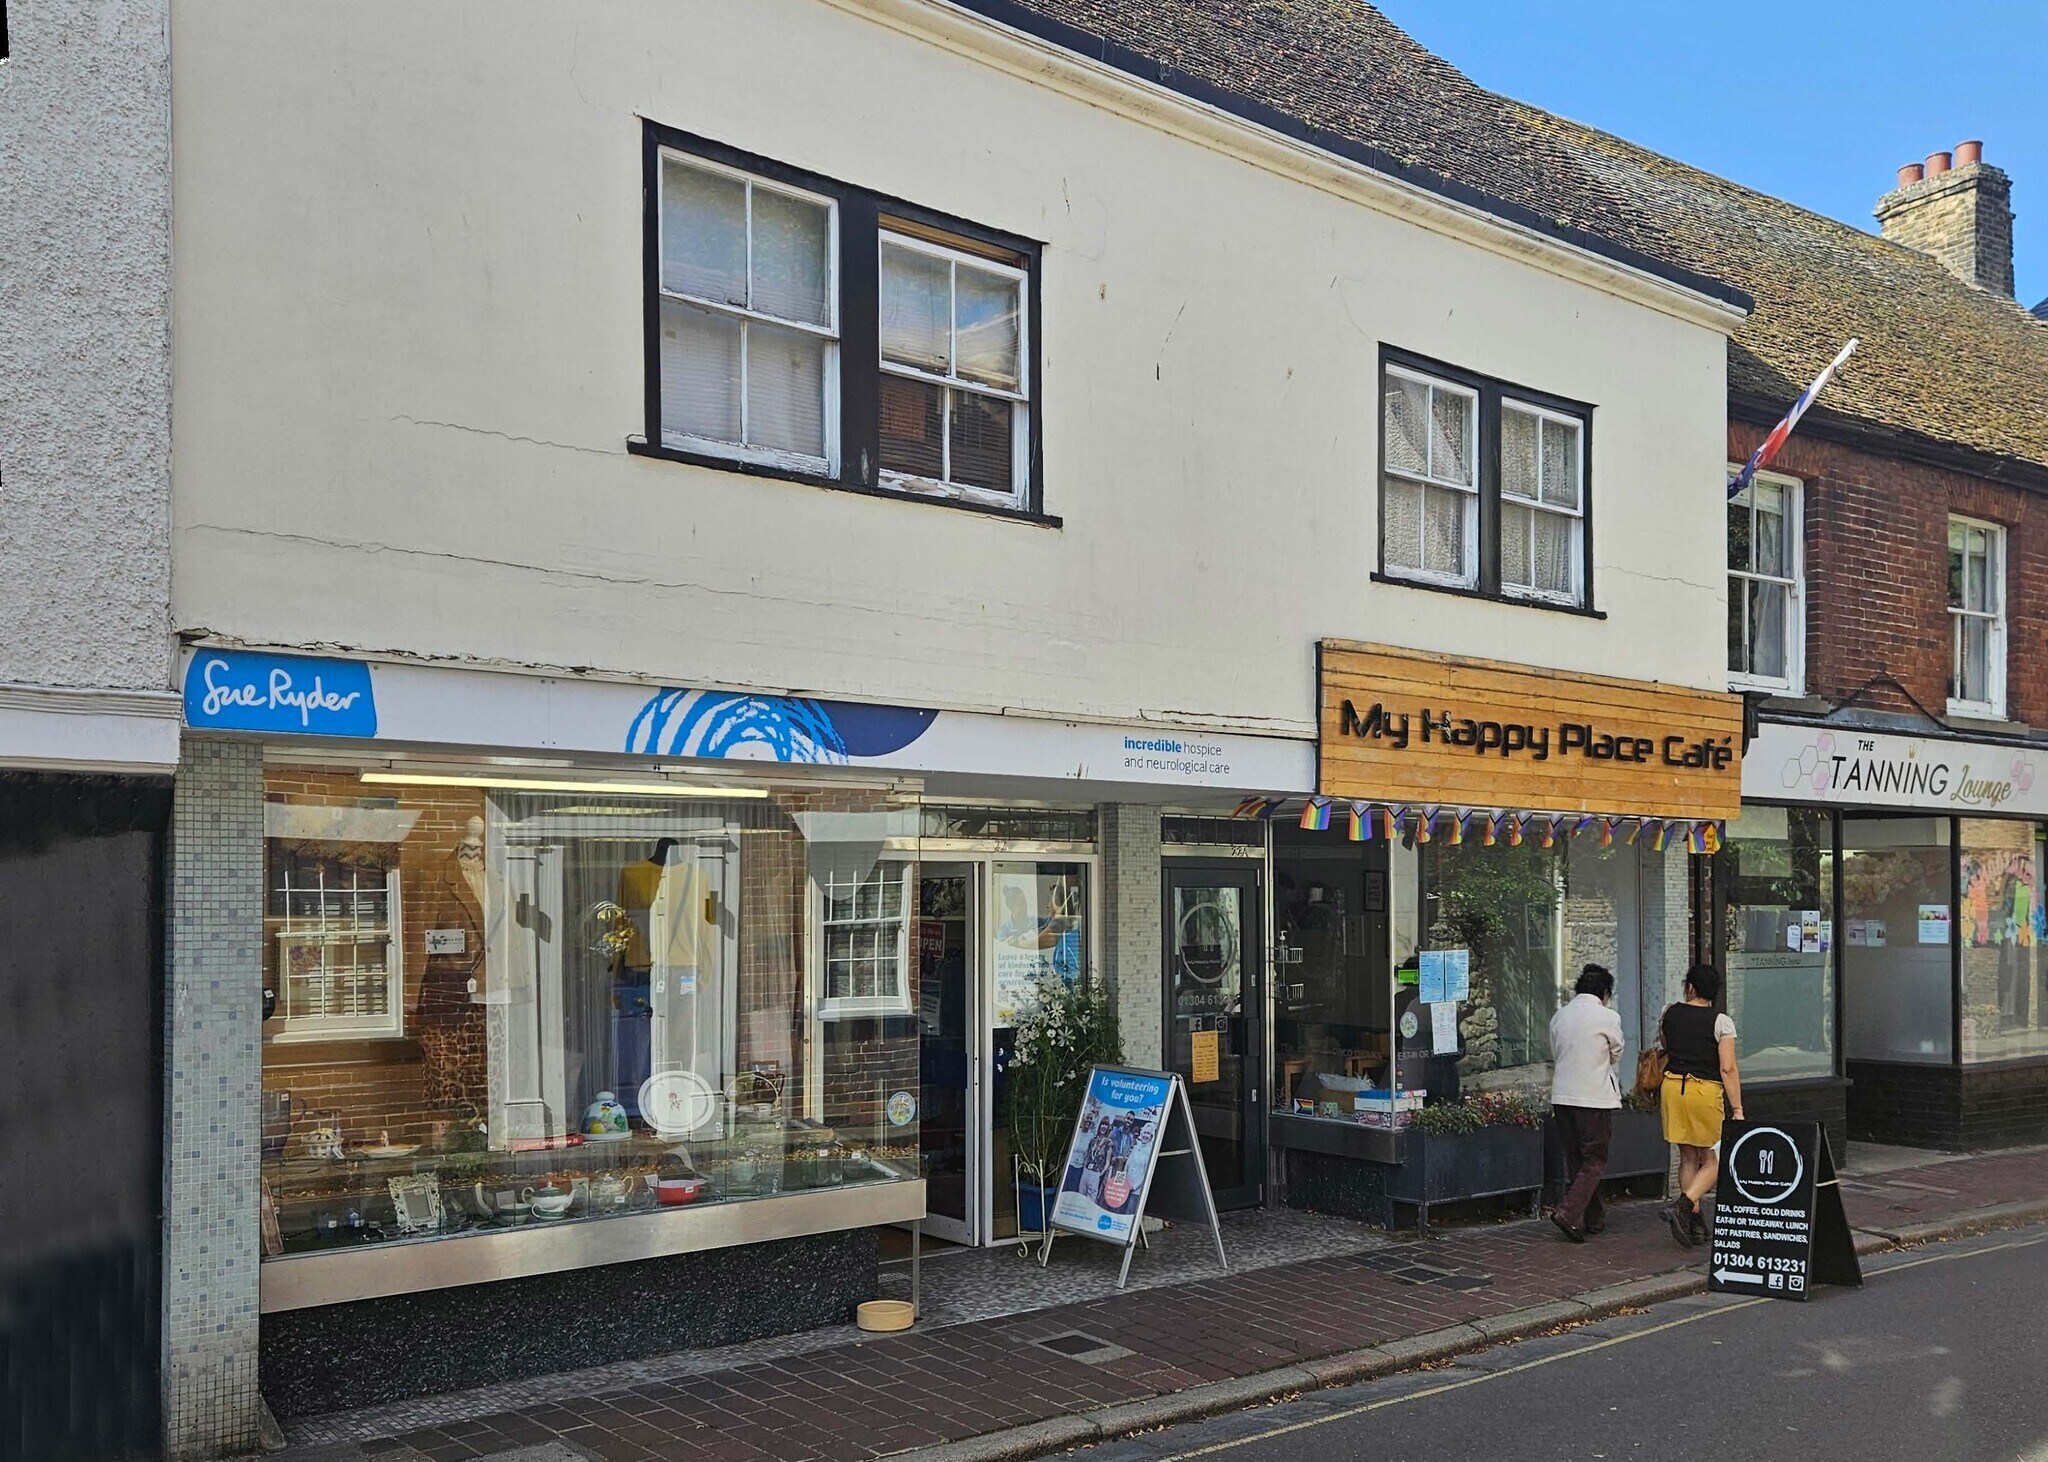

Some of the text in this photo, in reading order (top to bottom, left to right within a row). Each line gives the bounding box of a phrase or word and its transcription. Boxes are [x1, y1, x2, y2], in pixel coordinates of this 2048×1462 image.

[203, 659, 361, 726] Sue Ryder
[1340, 699, 1732, 770] My Happy Place Café
[1124, 736, 1222, 757] incredible hospice
[1858, 739, 1875, 751] THE
[1124, 756, 1230, 775] and neurological care
[1831, 756, 2012, 808] TANNING Lounge
[1101, 1076, 1160, 1095] Is volunteering
[1111, 1090, 1144, 1103] for you?
[1717, 1204, 1806, 1218] TEA, COFFEE, COLD DRINKS
[1715, 1215, 1809, 1231] EAT-IN OR TAKEAWAY, LUNCH
[1714, 1228, 1808, 1244] HOT PASTRIES, SANDWICHES,
[1714, 1239, 1741, 1250] SALADS
[1713, 1252, 1806, 1274] 01304 613231
